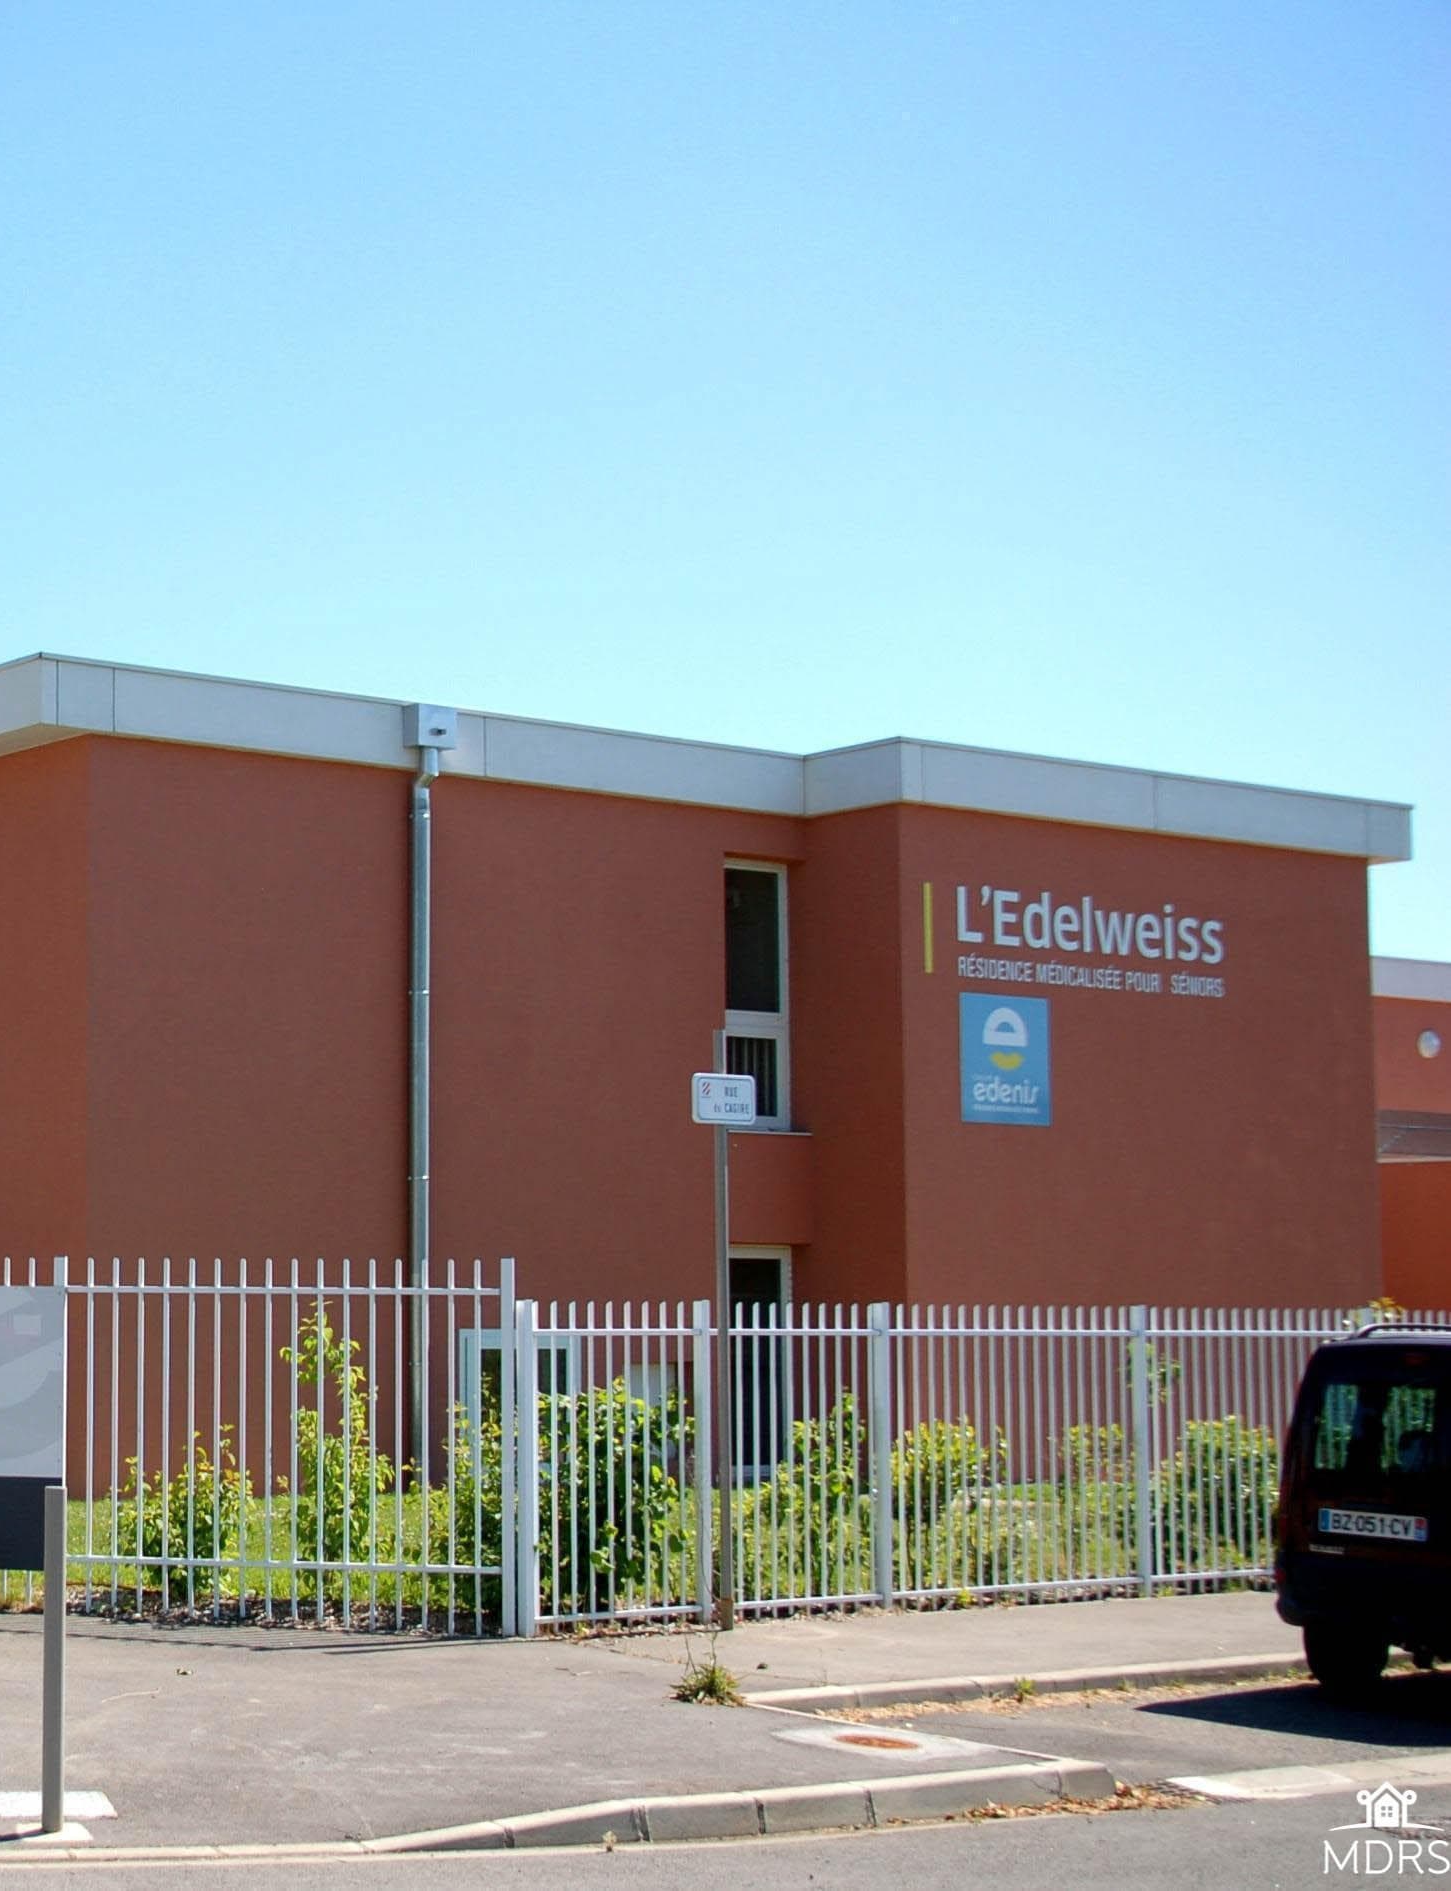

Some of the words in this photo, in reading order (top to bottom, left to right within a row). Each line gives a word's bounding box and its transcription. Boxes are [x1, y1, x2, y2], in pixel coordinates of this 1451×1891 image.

[956, 885, 1225, 965] L'Edelweiss
[957, 953, 1033, 983] RÉSIDENCE
[1035, 961, 1122, 991] MÉDICALISÉE
[1125, 971, 1162, 993] POUR
[1170, 971, 1225, 998] SÉNIORS
[973, 1075, 1040, 1104] edenis
